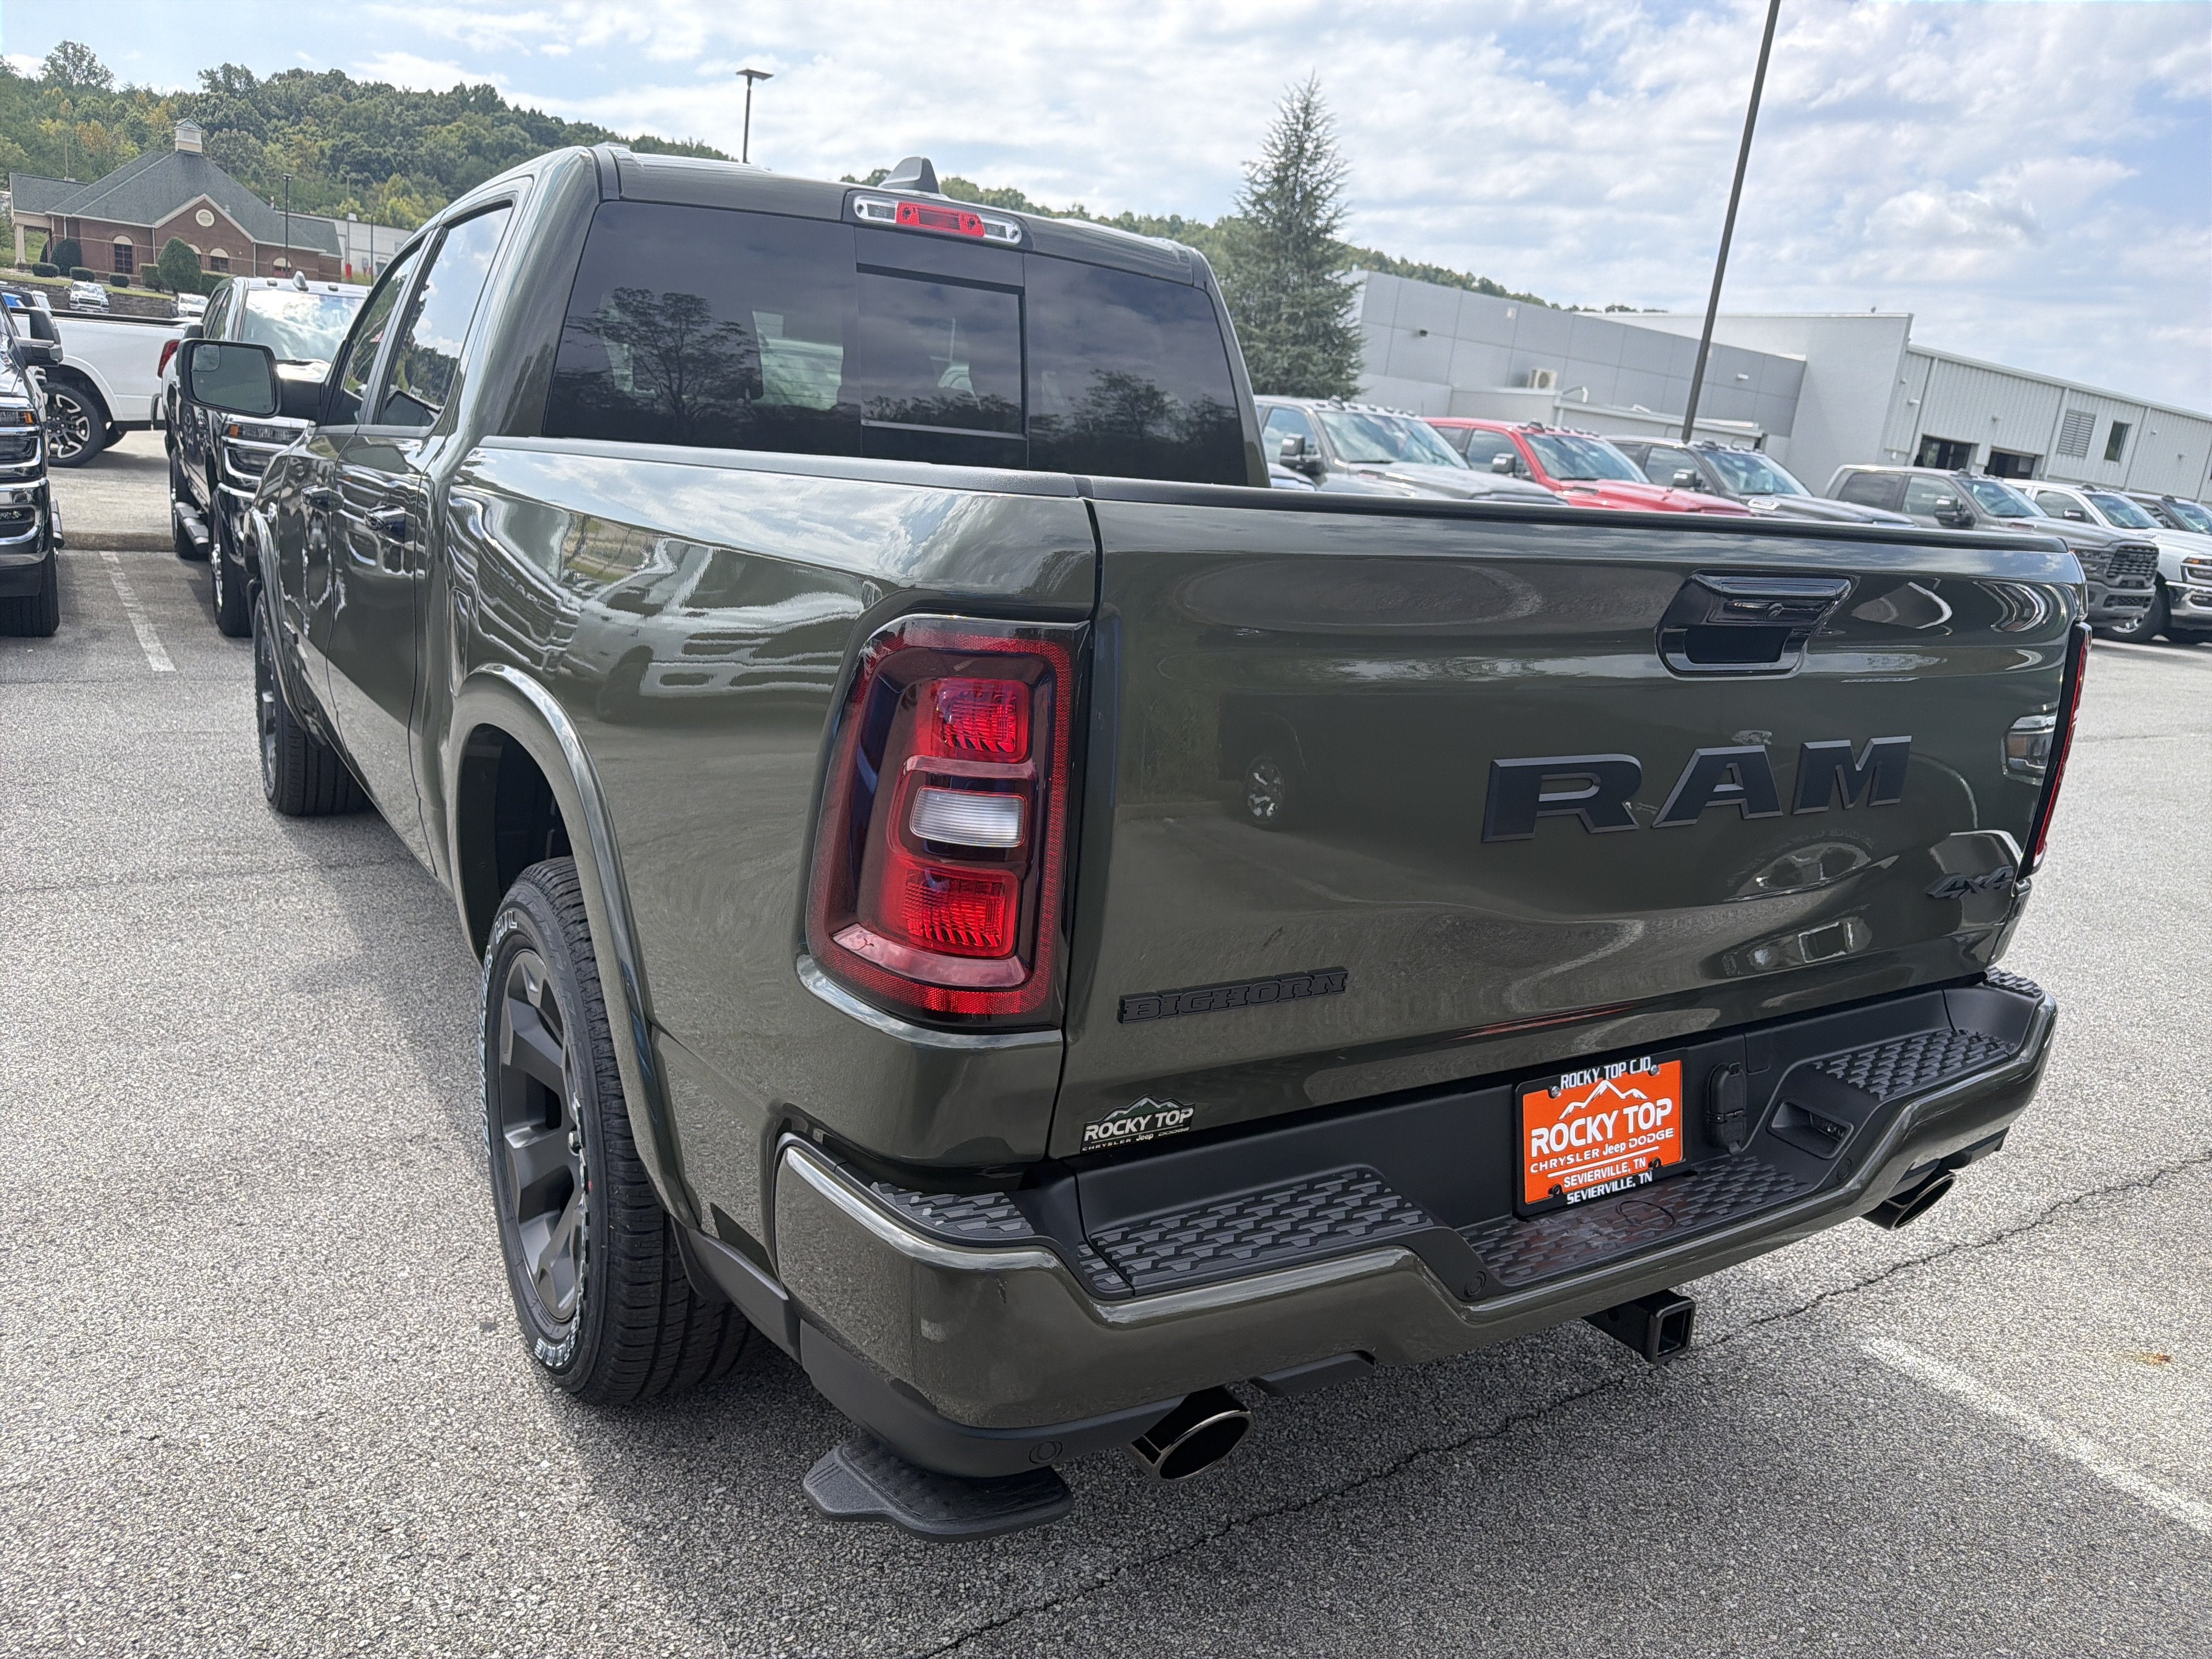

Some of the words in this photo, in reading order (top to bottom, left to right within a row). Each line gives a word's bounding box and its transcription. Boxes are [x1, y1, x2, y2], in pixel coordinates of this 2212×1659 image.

[1482, 735, 1912, 843] RAM
[1117, 966, 1348, 1024] BIGHORN
[1560, 1069, 1600, 1090] ROCKY
[1604, 1063, 1627, 1080] TOP
[1082, 1138, 1132, 1152] CHRYSLER
[1136, 1132, 1154, 1142] Jeep
[1158, 1126, 1190, 1137] DODGE
[1084, 1115, 1152, 1142] ROCKY
[1155, 1108, 1194, 1128] TOP
[1531, 1110, 1618, 1158] ROCKY
[1623, 1097, 1673, 1134] TOP
[1530, 1148, 1600, 1174] CHRYSLER
[1602, 1142, 1626, 1157] Jeep
[1628, 1127, 1674, 1149] DODGE
[1564, 1166, 1632, 1188] SEVIERVILLE,
[1633, 1156, 1646, 1170] TN
[1566, 1177, 1637, 1205] SEVIERVILLE,
[1639, 1171, 1653, 1185] TN
